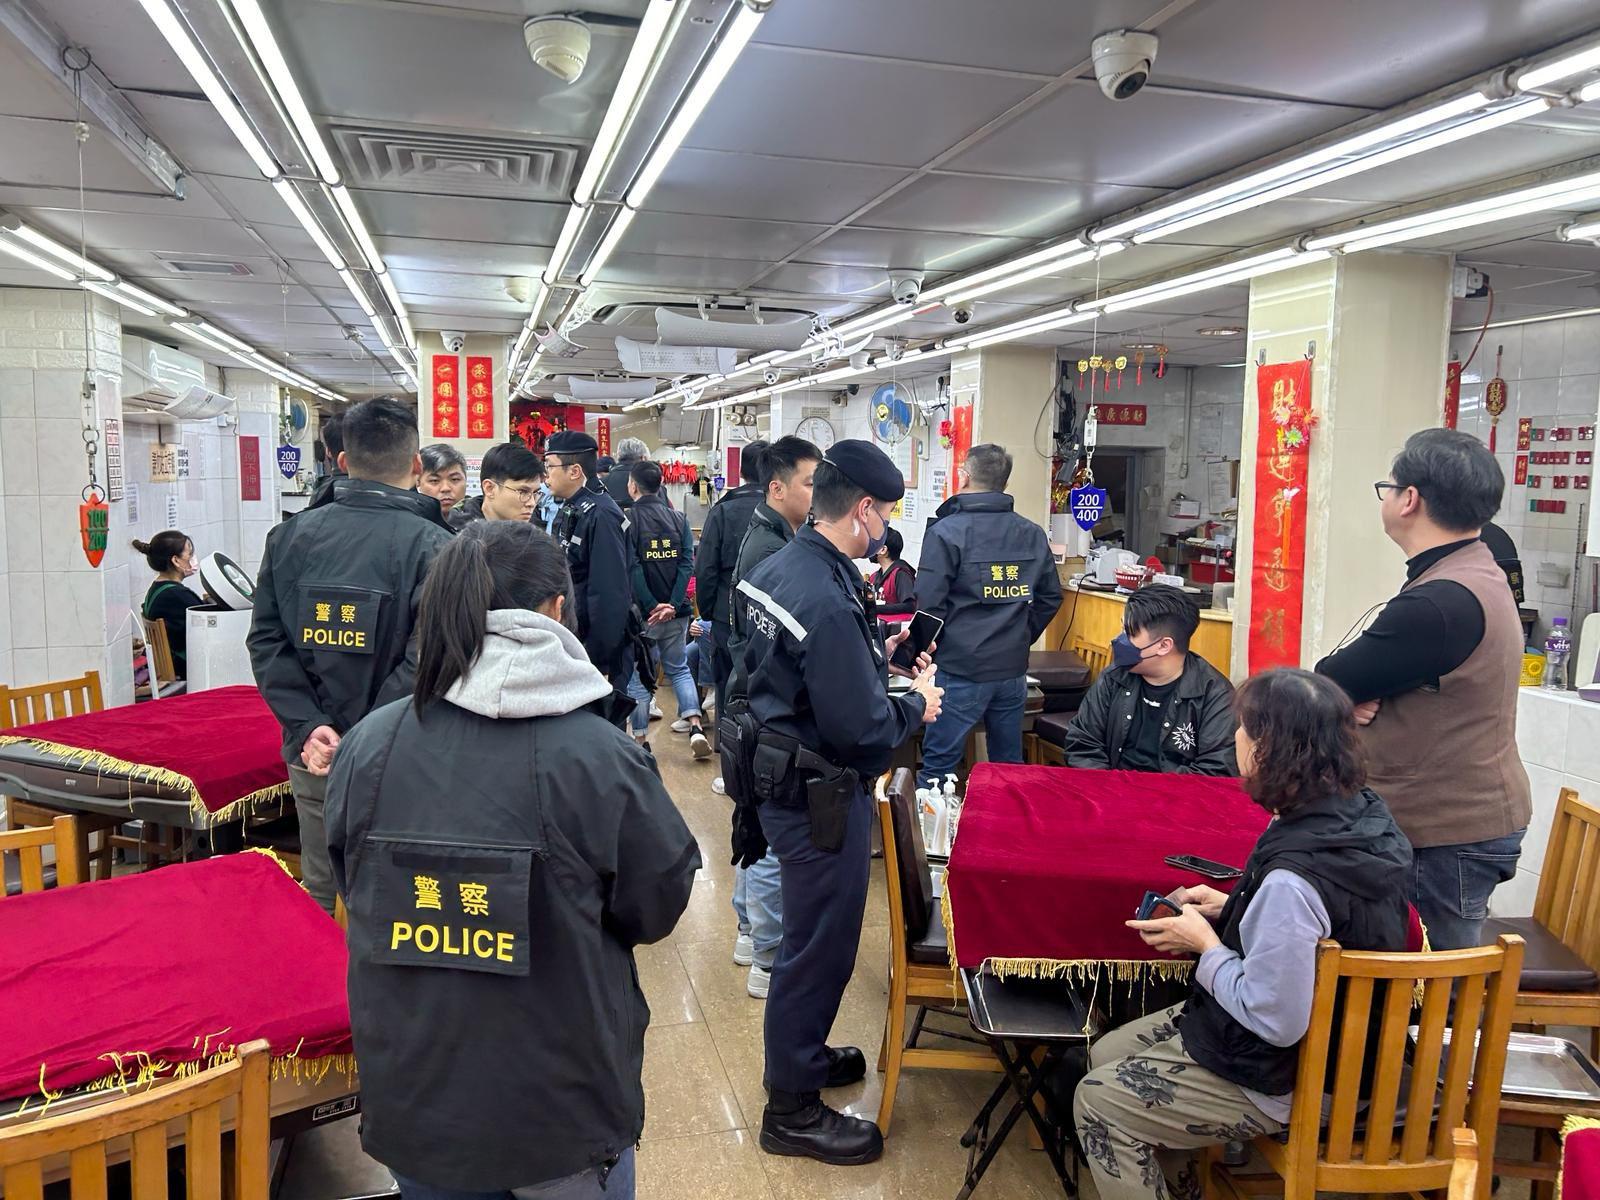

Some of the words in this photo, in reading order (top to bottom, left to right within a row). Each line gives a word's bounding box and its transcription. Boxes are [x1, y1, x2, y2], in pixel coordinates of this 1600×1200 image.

[281, 451, 296, 461] 200
[281, 463, 297, 473] 400
[1077, 494, 1100, 507] 200
[1076, 509, 1099, 522] 400
[651, 539, 671, 549] 警察
[646, 549, 678, 559] POLICE
[991, 565, 1019, 581] 警察
[983, 585, 1030, 599] POLICE
[315, 602, 356, 623] 警察
[303, 627, 365, 647] POLICE
[413, 875, 489, 917] 警察
[391, 922, 514, 961] POLICE
